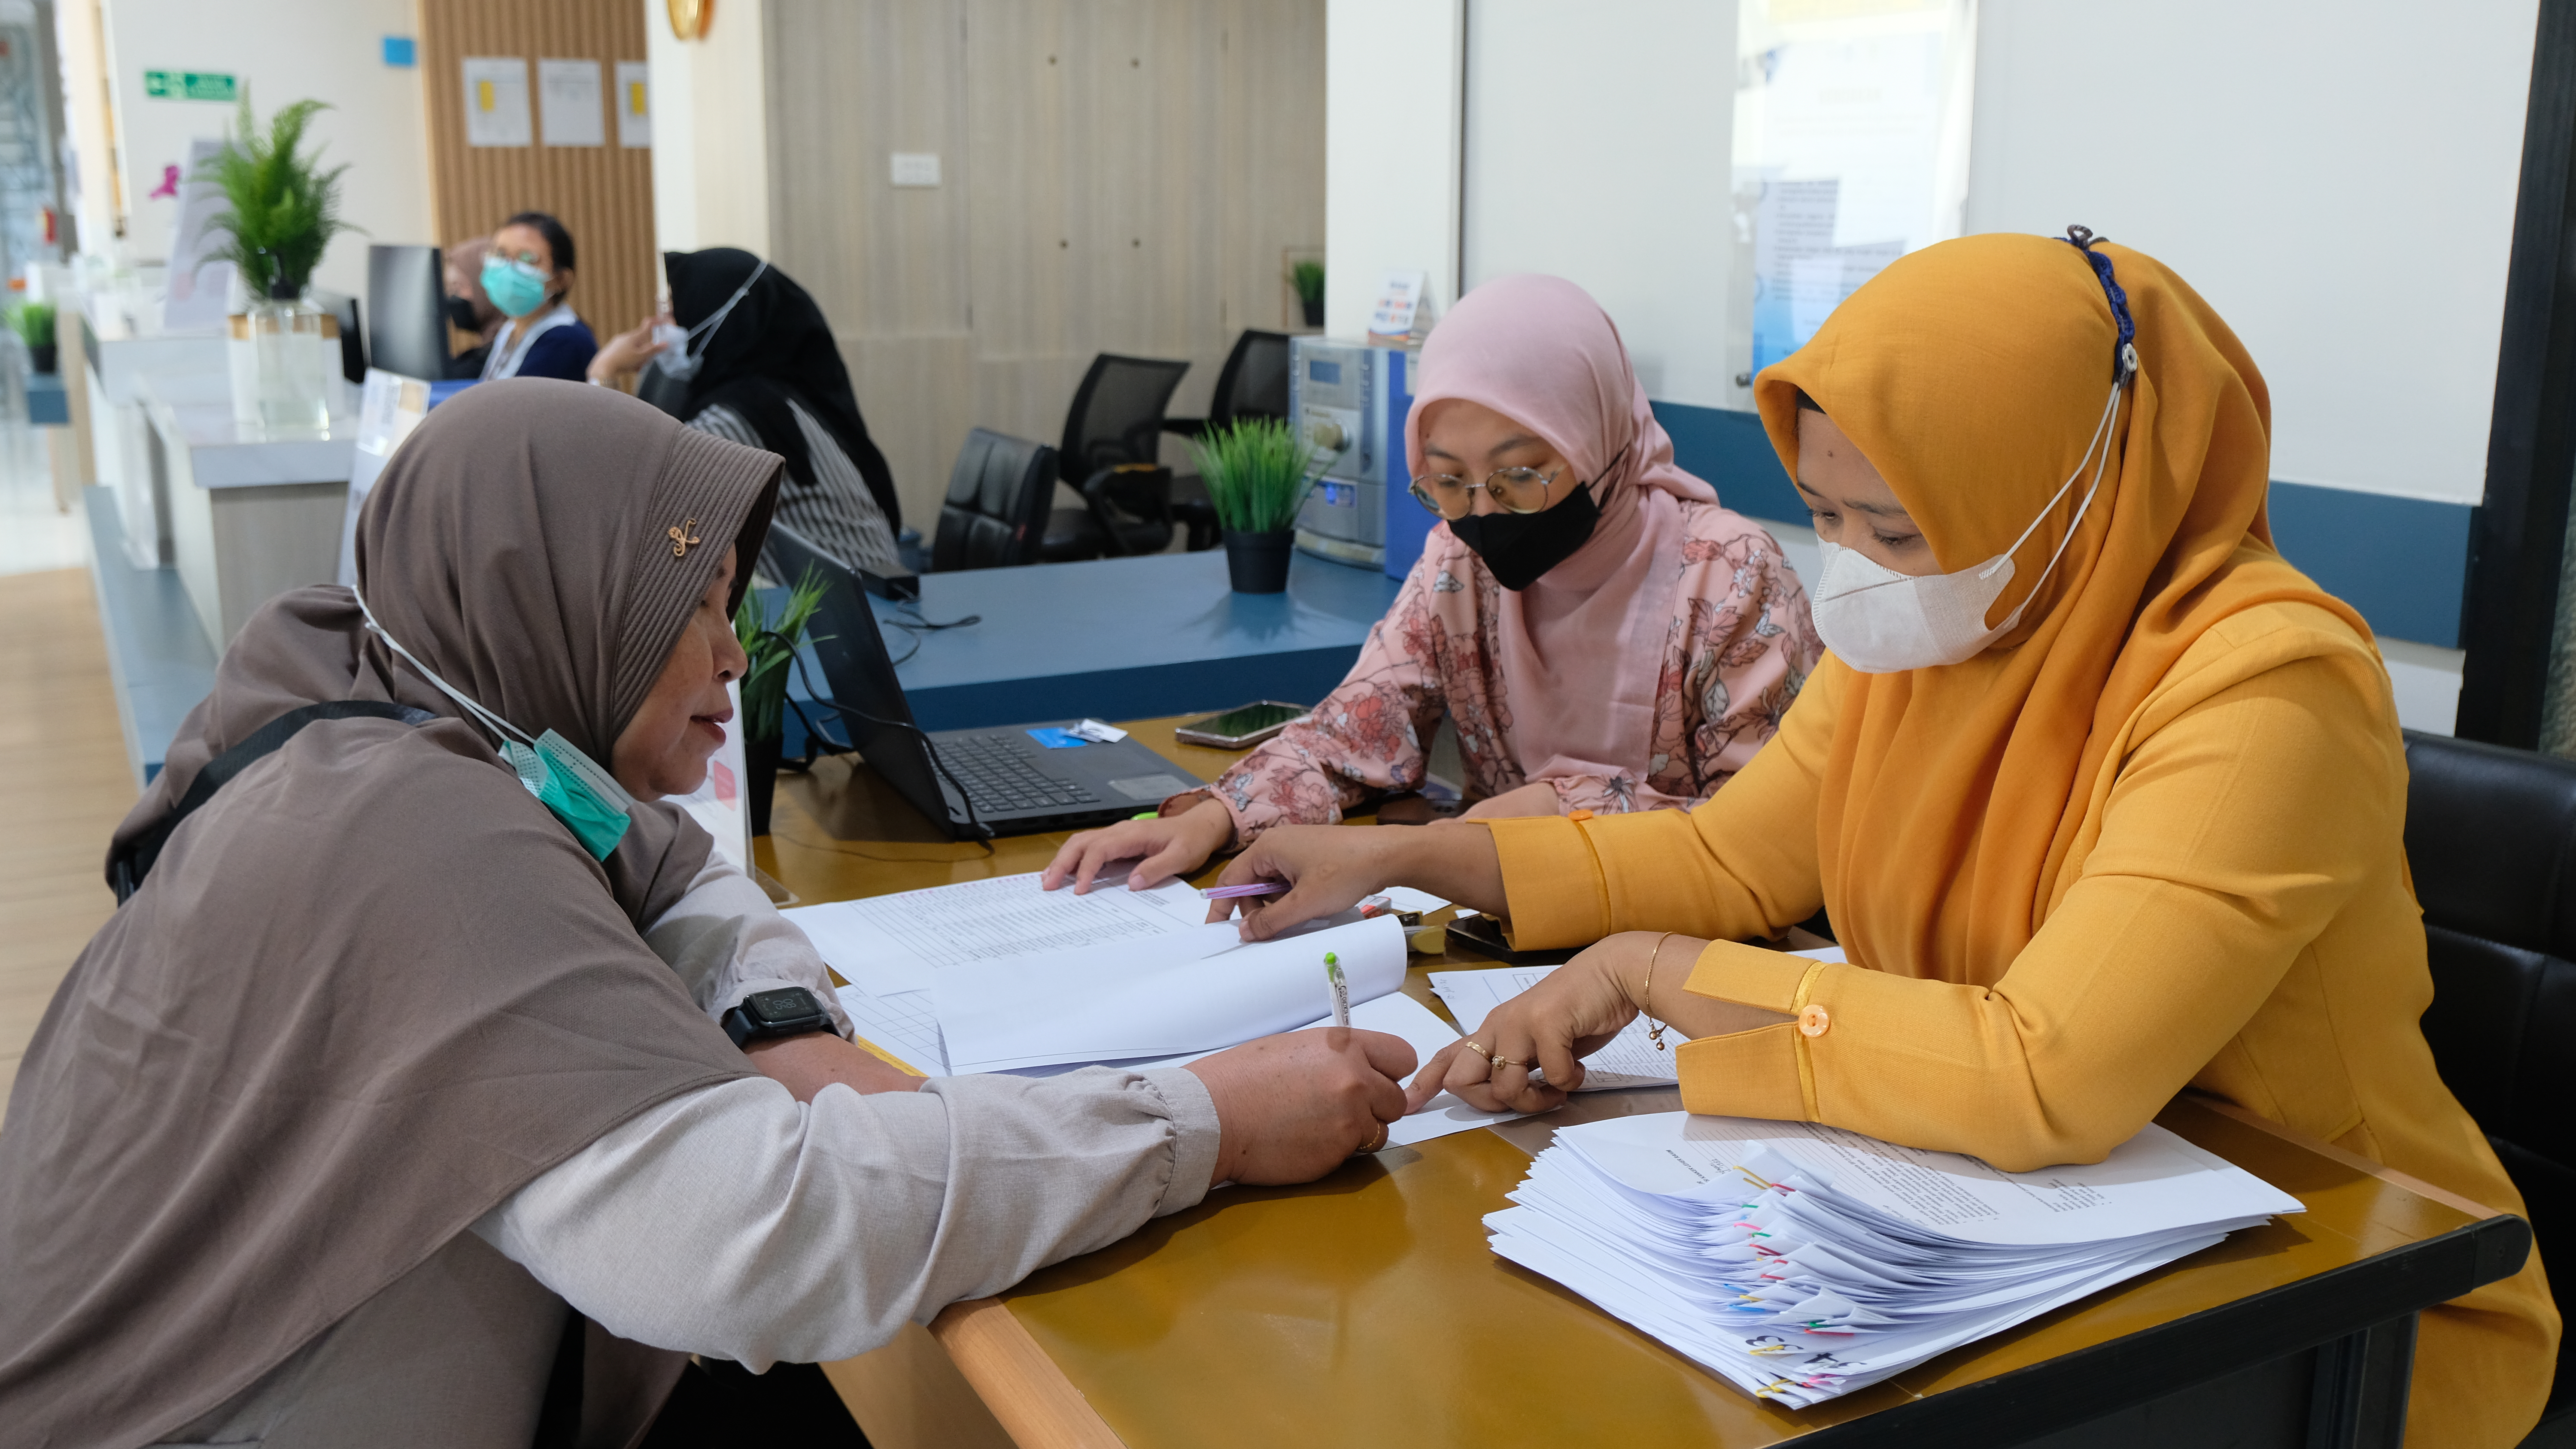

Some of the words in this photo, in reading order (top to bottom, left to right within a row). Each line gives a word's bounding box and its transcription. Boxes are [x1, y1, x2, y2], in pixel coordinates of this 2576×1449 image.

[1665, 1149, 1680, 1158] RAHIM
[1676, 1158, 1691, 1167] LEHER
[1688, 1167, 1706, 1179] KANKER
